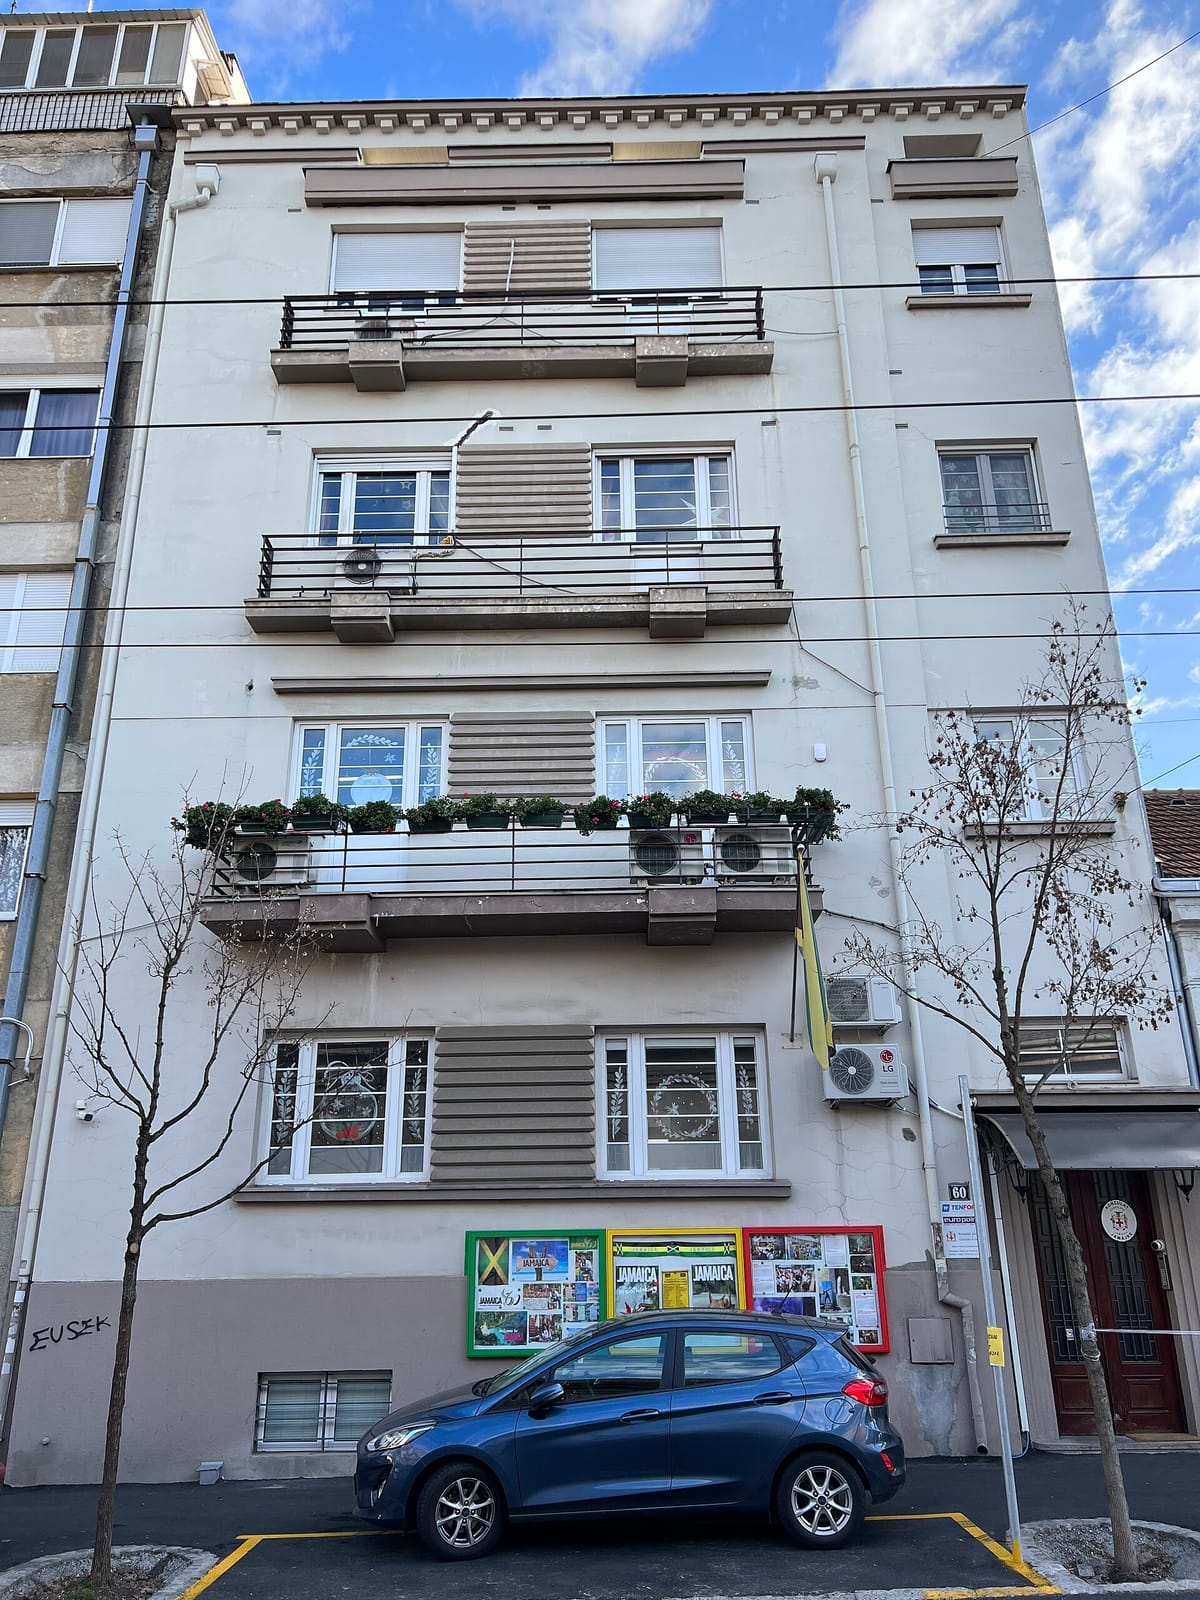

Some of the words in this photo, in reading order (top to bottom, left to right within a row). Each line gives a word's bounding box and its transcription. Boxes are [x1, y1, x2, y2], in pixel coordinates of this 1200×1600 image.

[952, 1186, 967, 1199] 60
[523, 1258, 550, 1267] JAMAICA
[617, 1267, 658, 1282] JAMAICA
[694, 1265, 733, 1280] JAMAICA
[479, 1296, 503, 1304] JAMAICA
[29, 1315, 112, 1352] EUSEK
